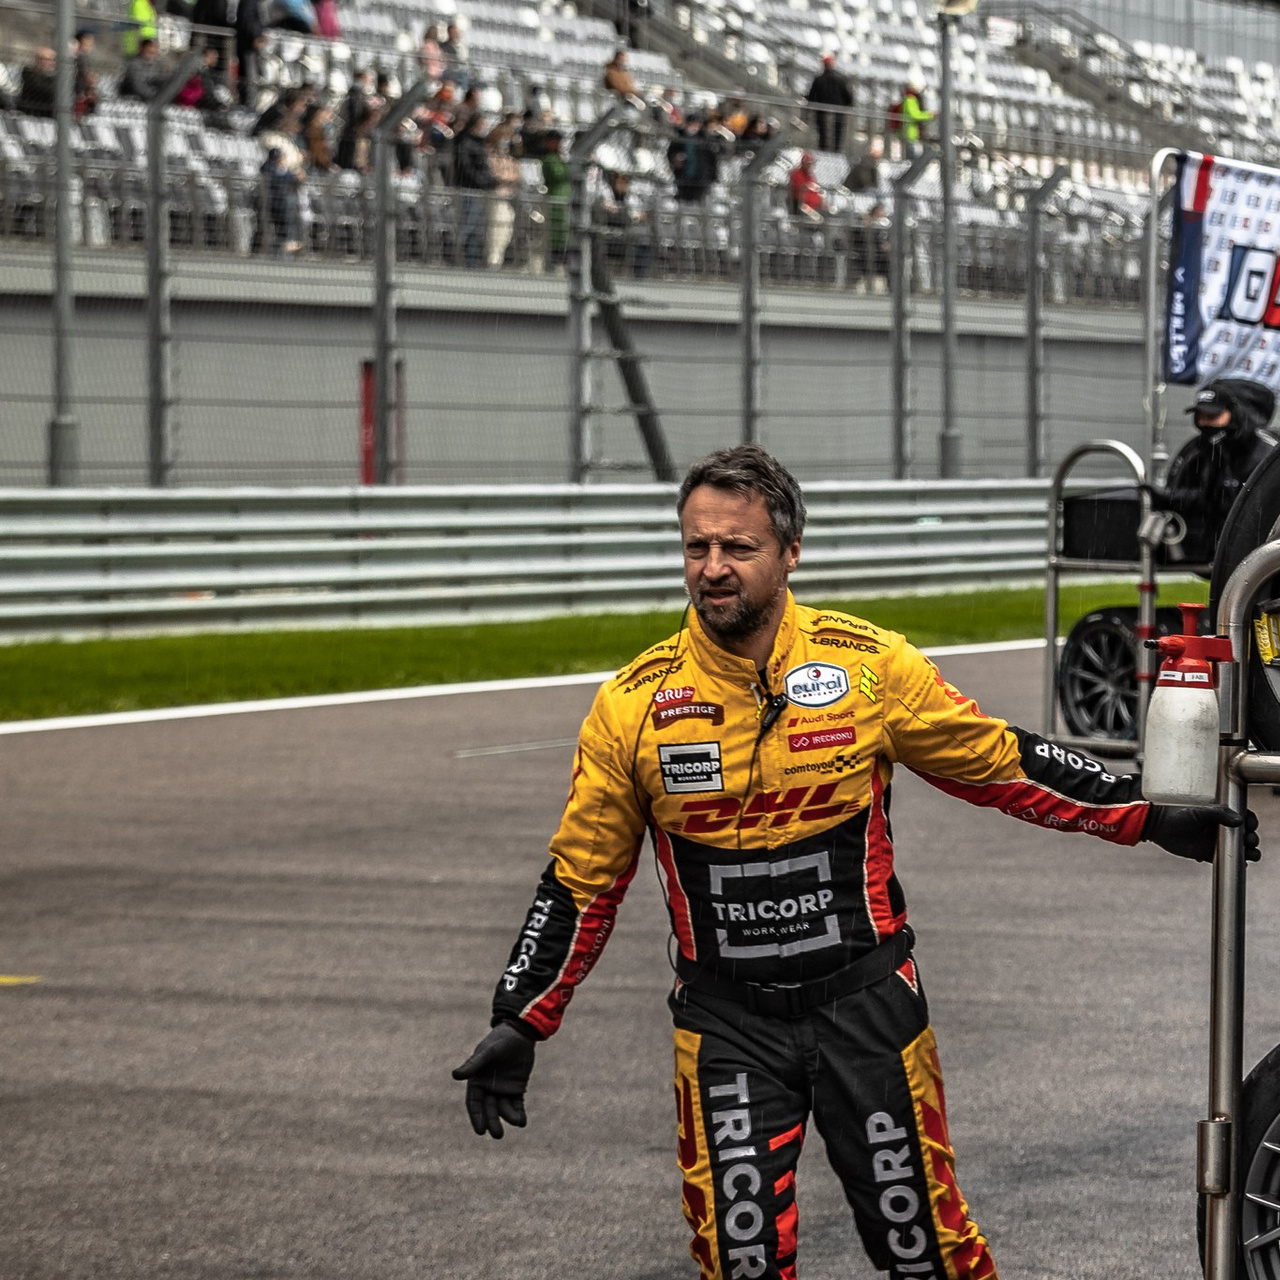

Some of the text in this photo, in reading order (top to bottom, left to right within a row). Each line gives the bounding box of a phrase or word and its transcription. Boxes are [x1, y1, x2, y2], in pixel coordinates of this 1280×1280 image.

[792, 673, 842, 695] eurol
[660, 705, 716, 719] PRESTIGE
[800, 710, 856, 725] Audi Sport
[812, 732, 853, 744] IRECKONU
[662, 762, 721, 776] TRICORP
[784, 760, 836, 775] comtoyou
[680, 782, 841, 834] DHL
[711, 889, 834, 922] TRICORP
